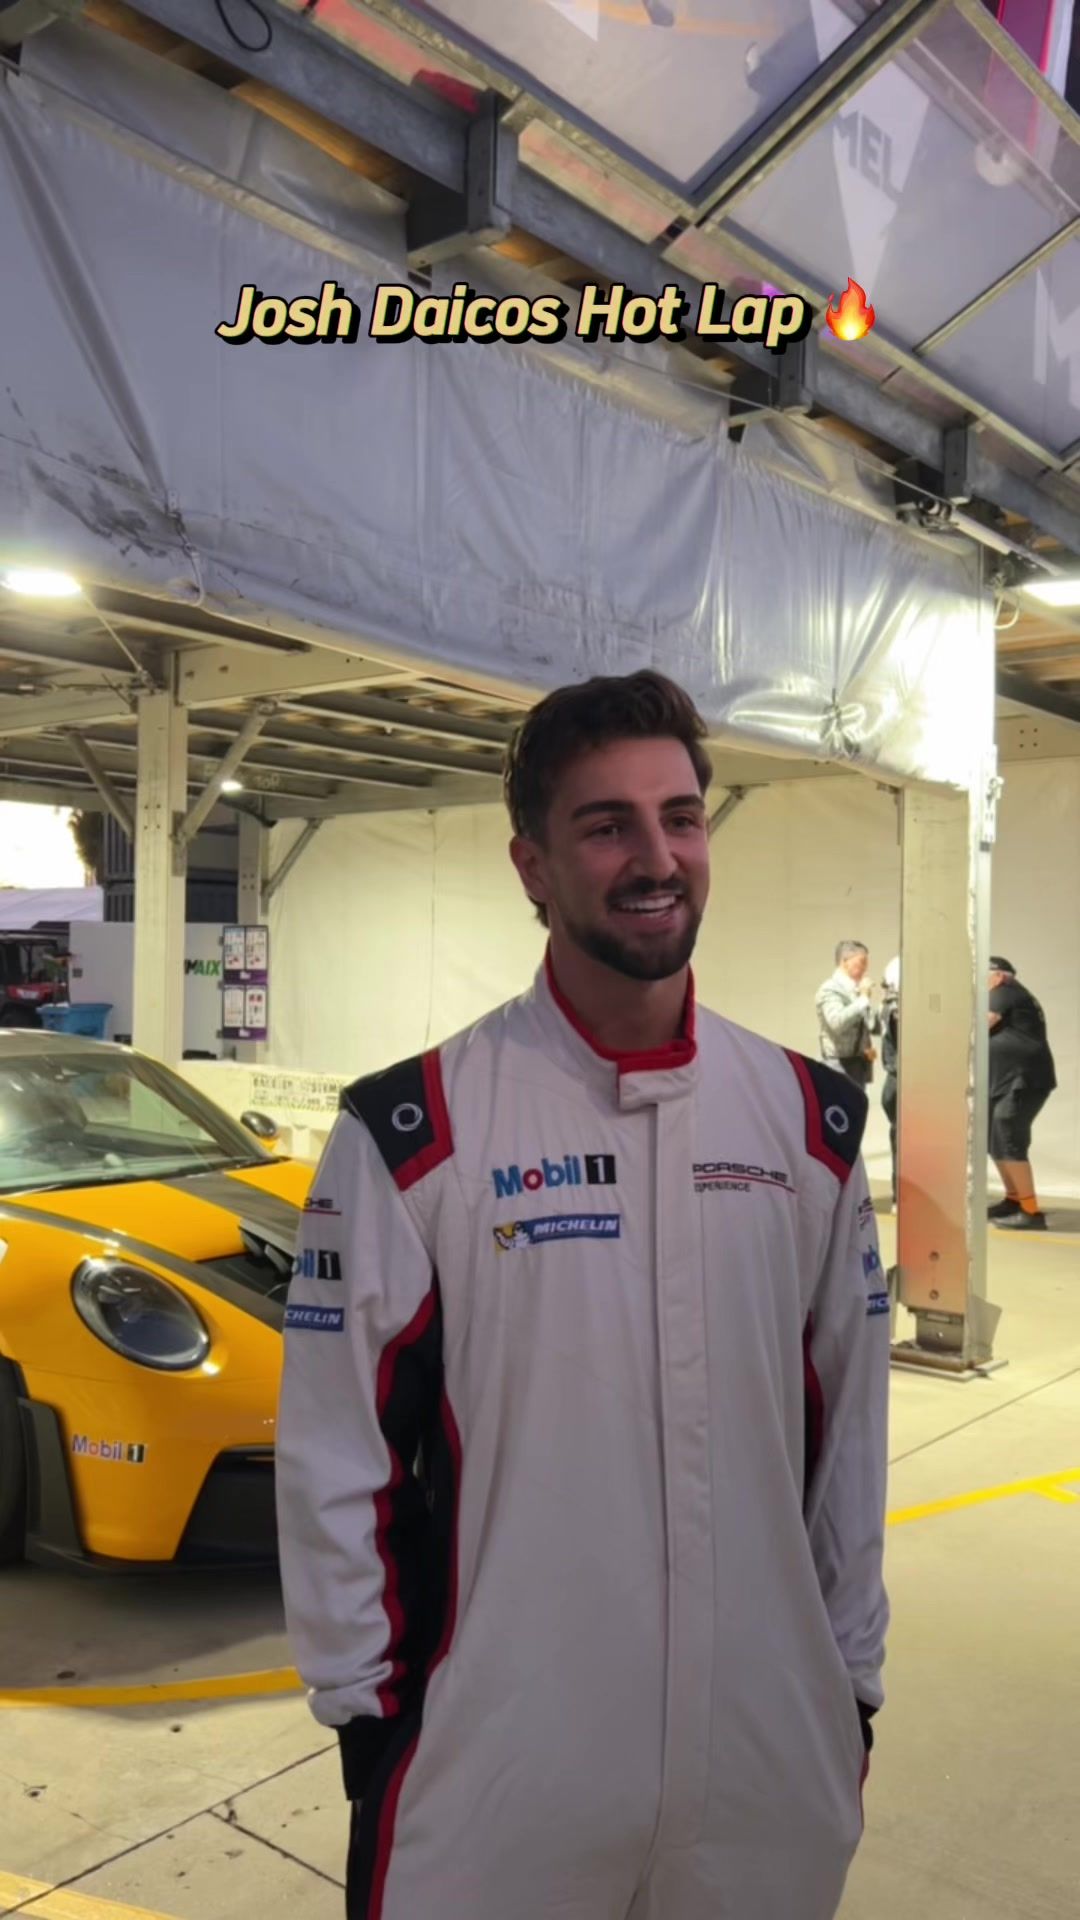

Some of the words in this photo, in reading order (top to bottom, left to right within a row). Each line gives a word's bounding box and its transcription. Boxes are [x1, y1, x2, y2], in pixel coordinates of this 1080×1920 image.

[492, 1154, 581, 1199] Mobil
[692, 1162, 788, 1184] PORSCHE
[533, 1219, 617, 1235] MICHELIN
[287, 1309, 341, 1325] CHELIN
[72, 1433, 122, 1460] Mobil
